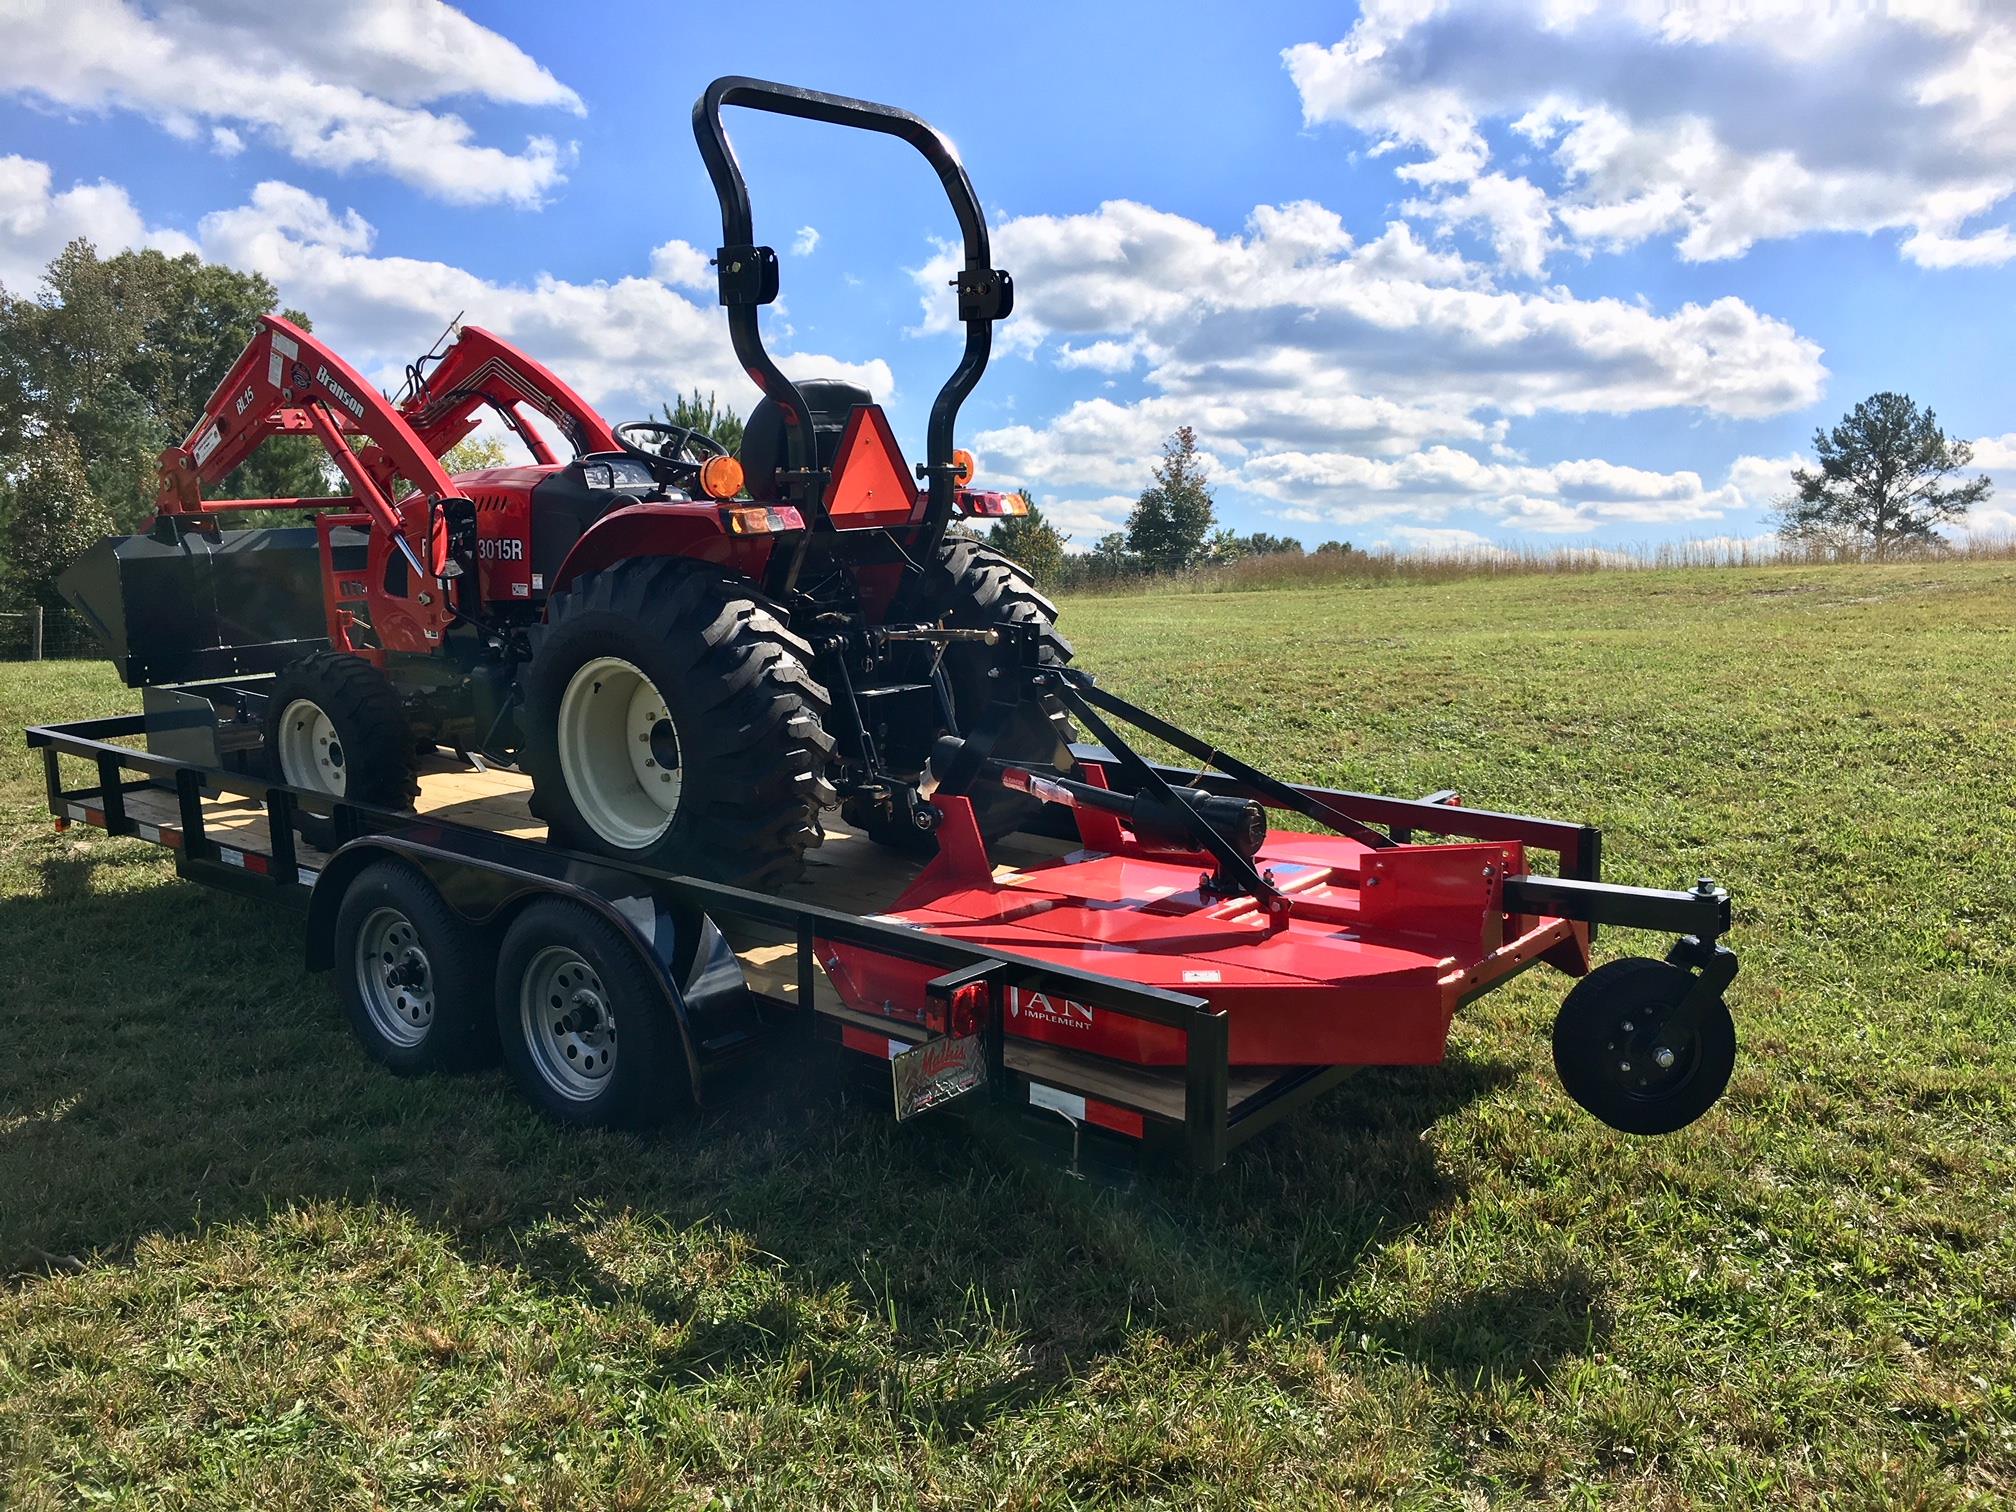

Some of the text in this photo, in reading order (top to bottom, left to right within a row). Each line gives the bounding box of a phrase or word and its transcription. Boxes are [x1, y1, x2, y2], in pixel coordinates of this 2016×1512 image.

[235, 384, 254, 416] BL15
[315, 364, 365, 418] Branson
[478, 539, 523, 560] 3015R
[1024, 1009, 1092, 1031] IMPLEMENT
